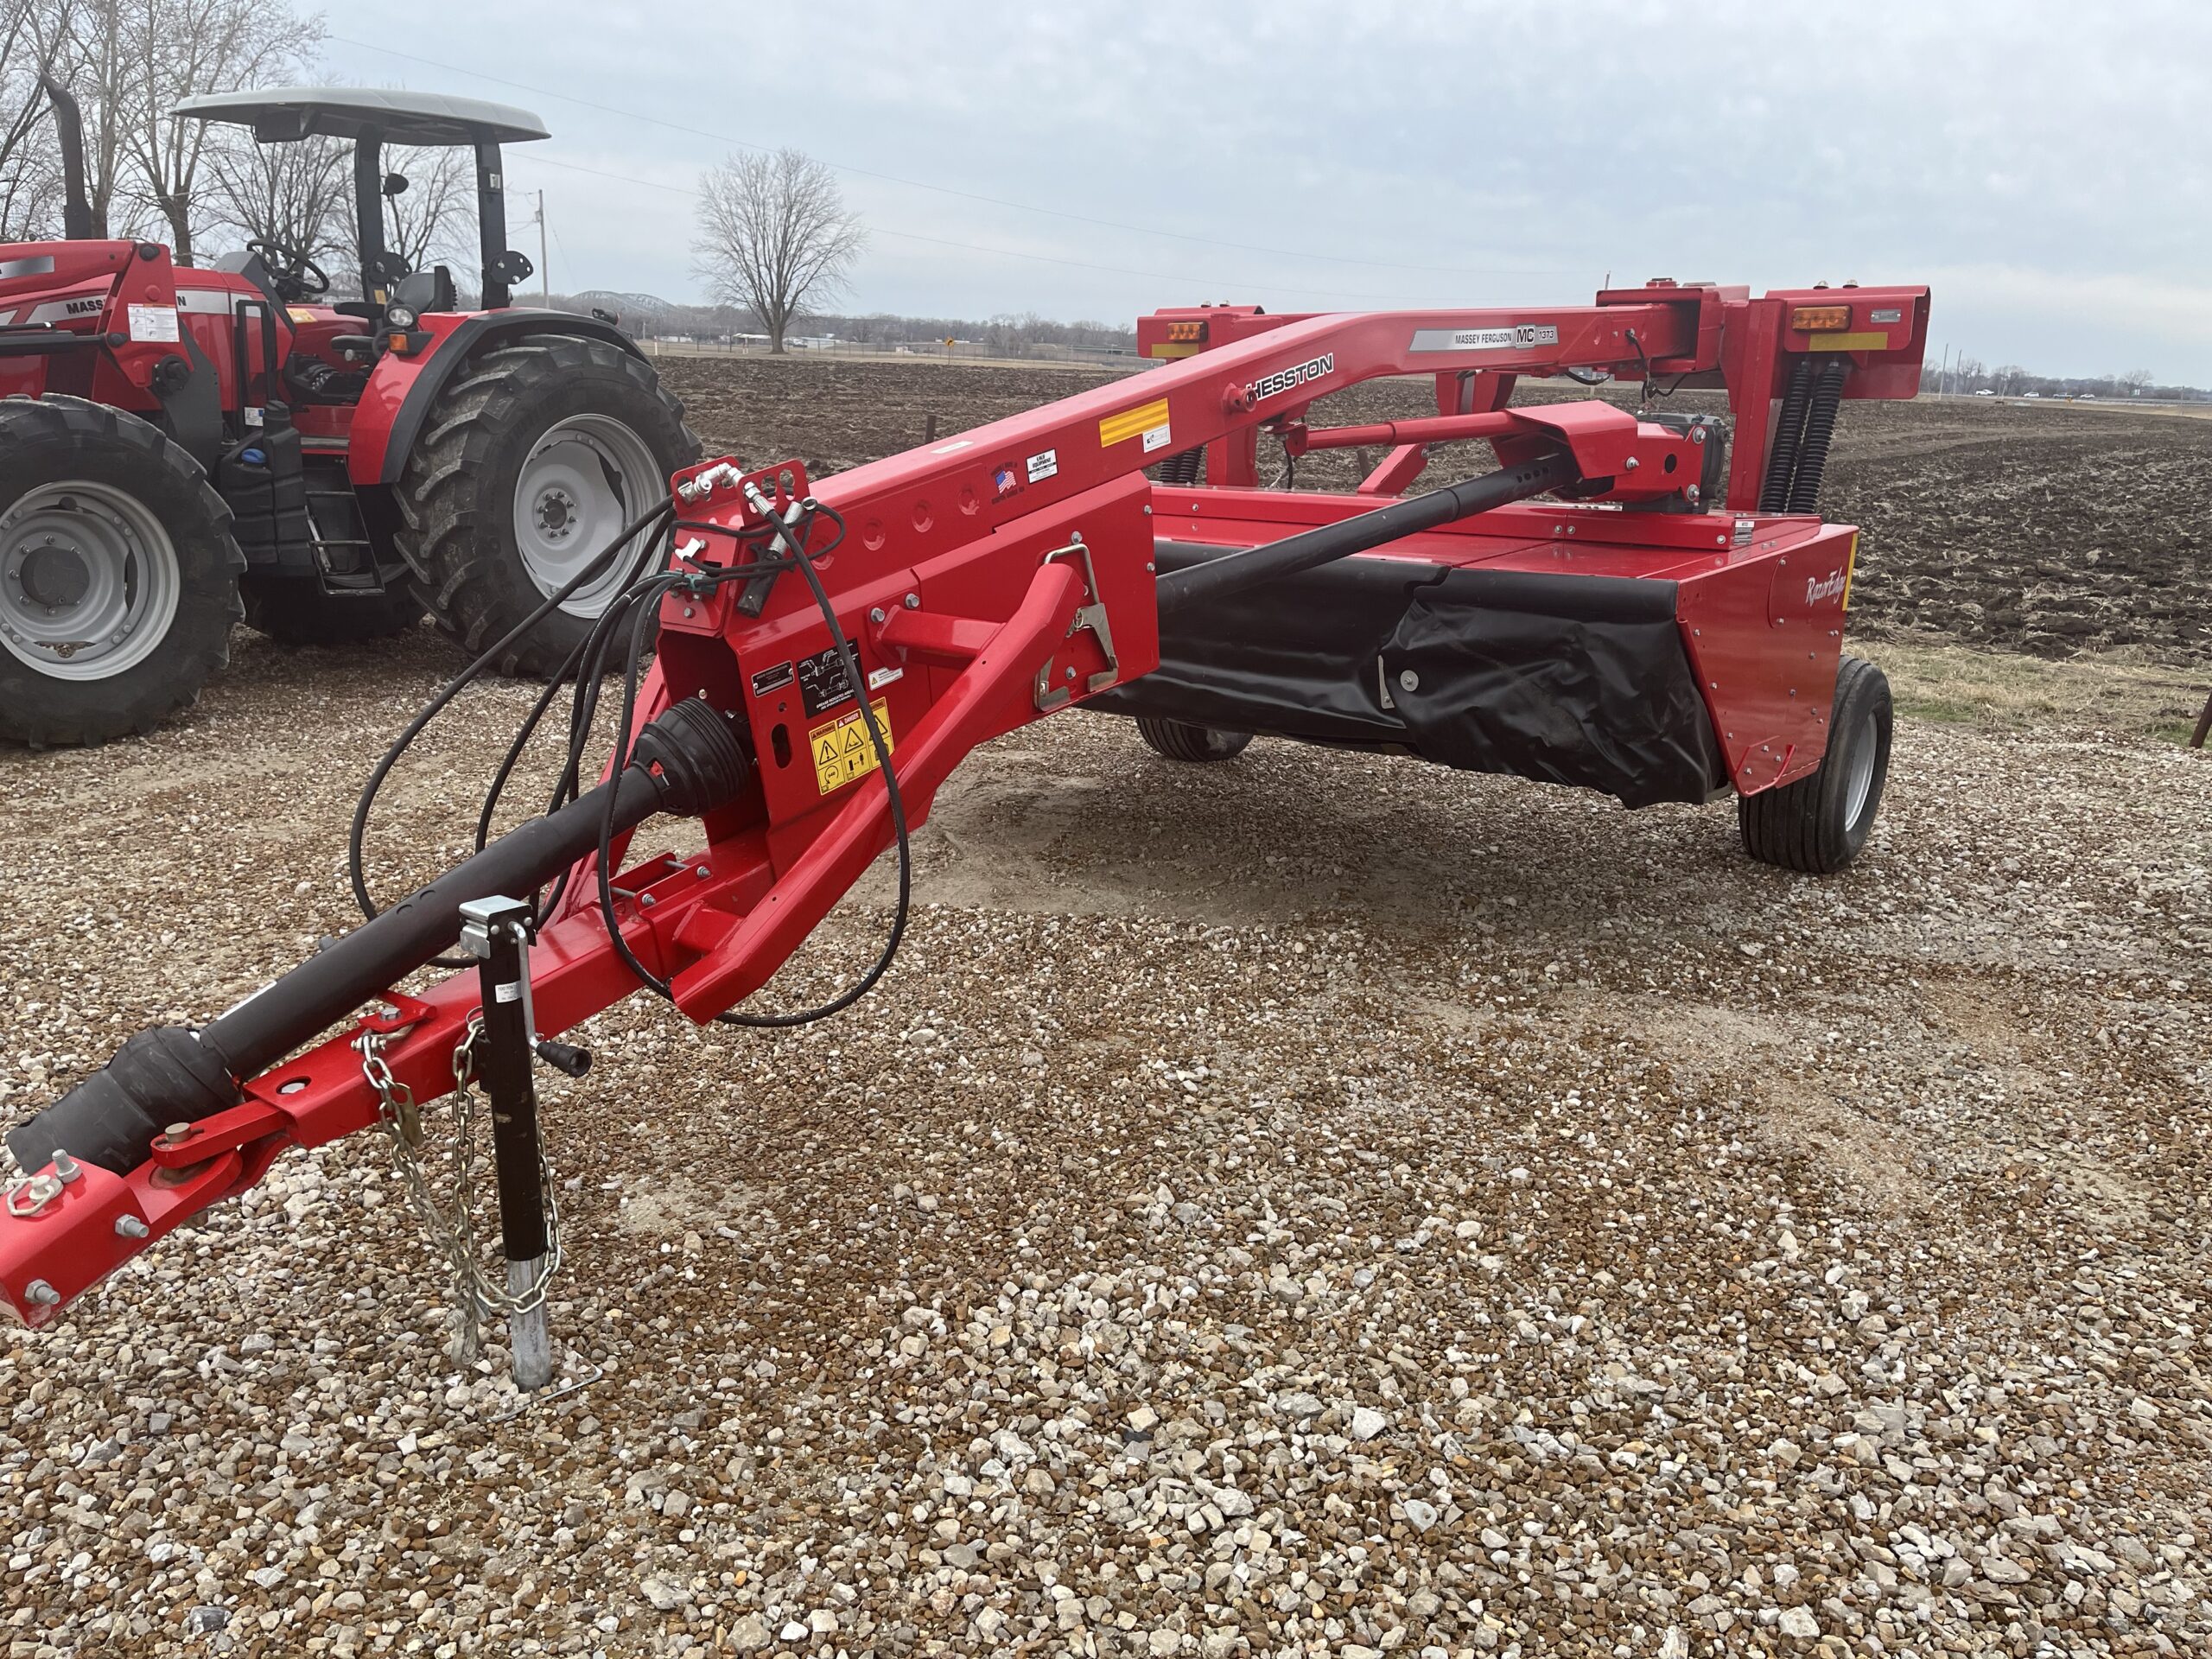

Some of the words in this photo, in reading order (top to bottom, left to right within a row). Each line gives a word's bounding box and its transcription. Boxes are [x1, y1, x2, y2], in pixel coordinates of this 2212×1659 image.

[66, 299, 105, 315] MASS
[1455, 334, 1480, 345] MASSEY
[1481, 333, 1512, 344] FERGUSON
[1516, 327, 1535, 344] MC
[1538, 330, 1554, 340] 1373
[1246, 353, 1334, 401] HESSTON
[843, 712, 860, 724] DANGER
